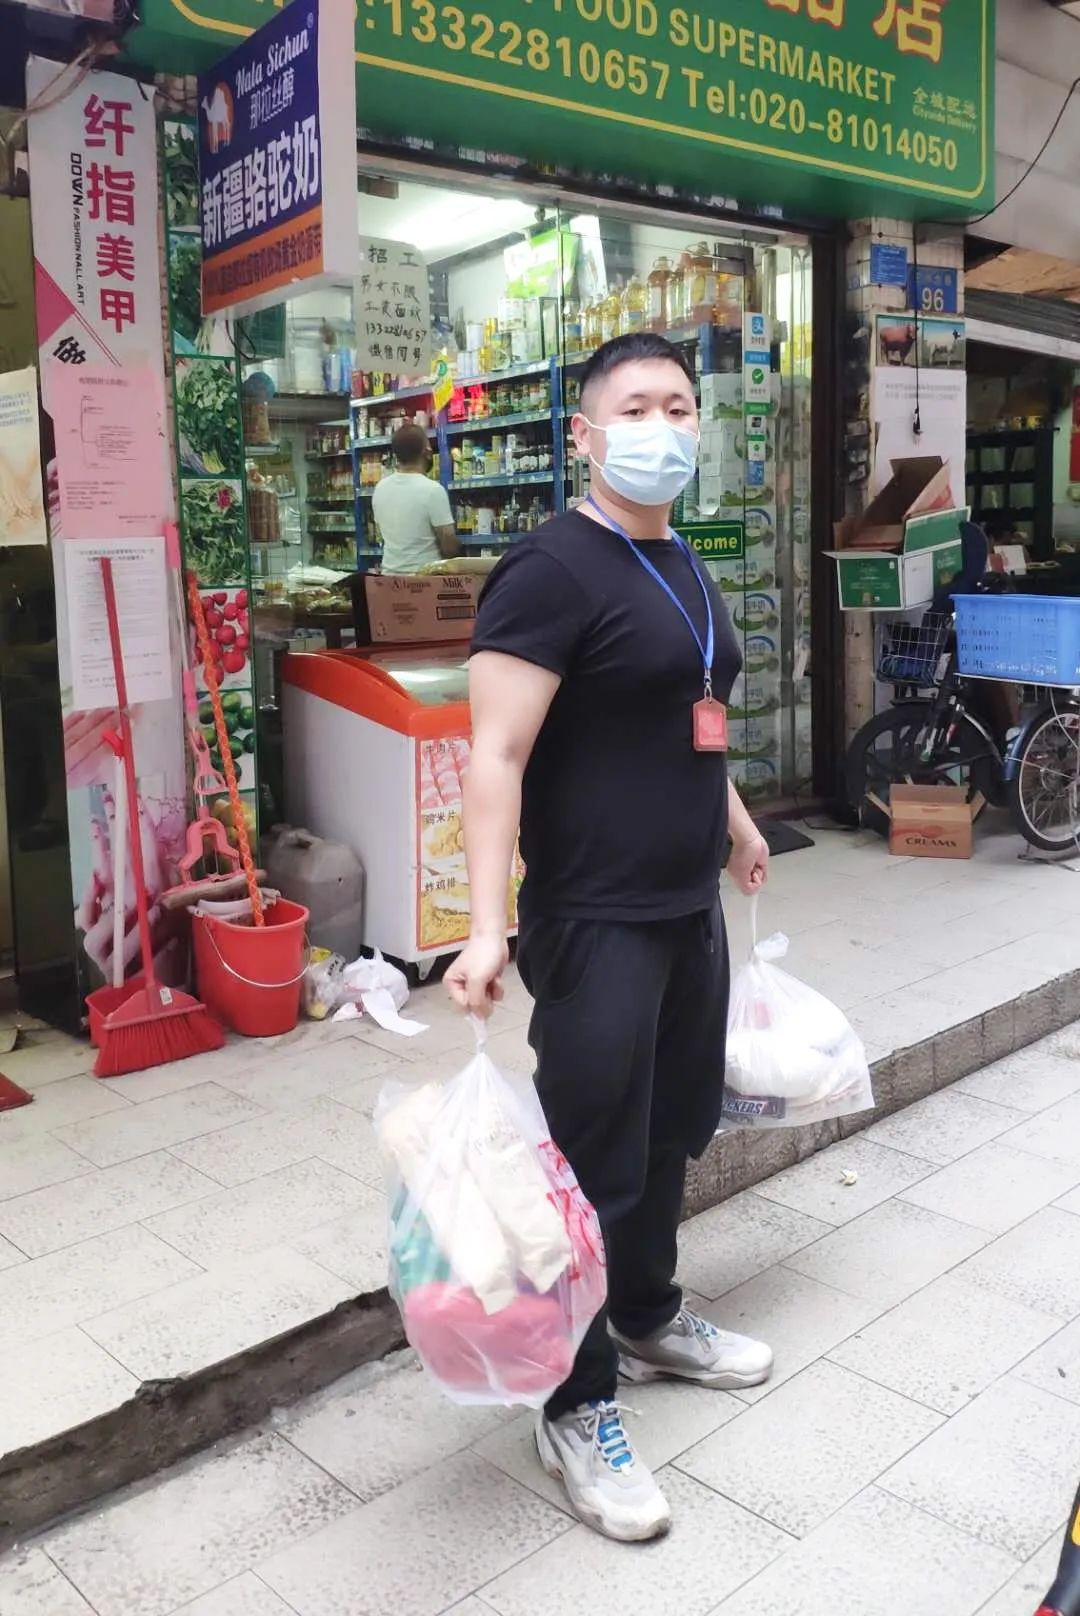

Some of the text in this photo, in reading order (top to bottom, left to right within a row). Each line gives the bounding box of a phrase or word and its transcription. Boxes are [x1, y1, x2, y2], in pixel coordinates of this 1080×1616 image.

[235, 61, 263, 98] Nala
[669, 8, 896, 105] SUPERMARKET
[354, 0, 958, 171] :13322810657 Tel:020-81014050
[70, 151, 84, 206] DOWN
[202, 114, 320, 248] 新疆骆驼奶
[83, 93, 136, 334] 纤指美甲
[367, 244, 419, 268] 招工
[360, 274, 421, 304] 男女不限
[922, 287, 944, 312] 96
[905, 837, 957, 848] CREAMS
